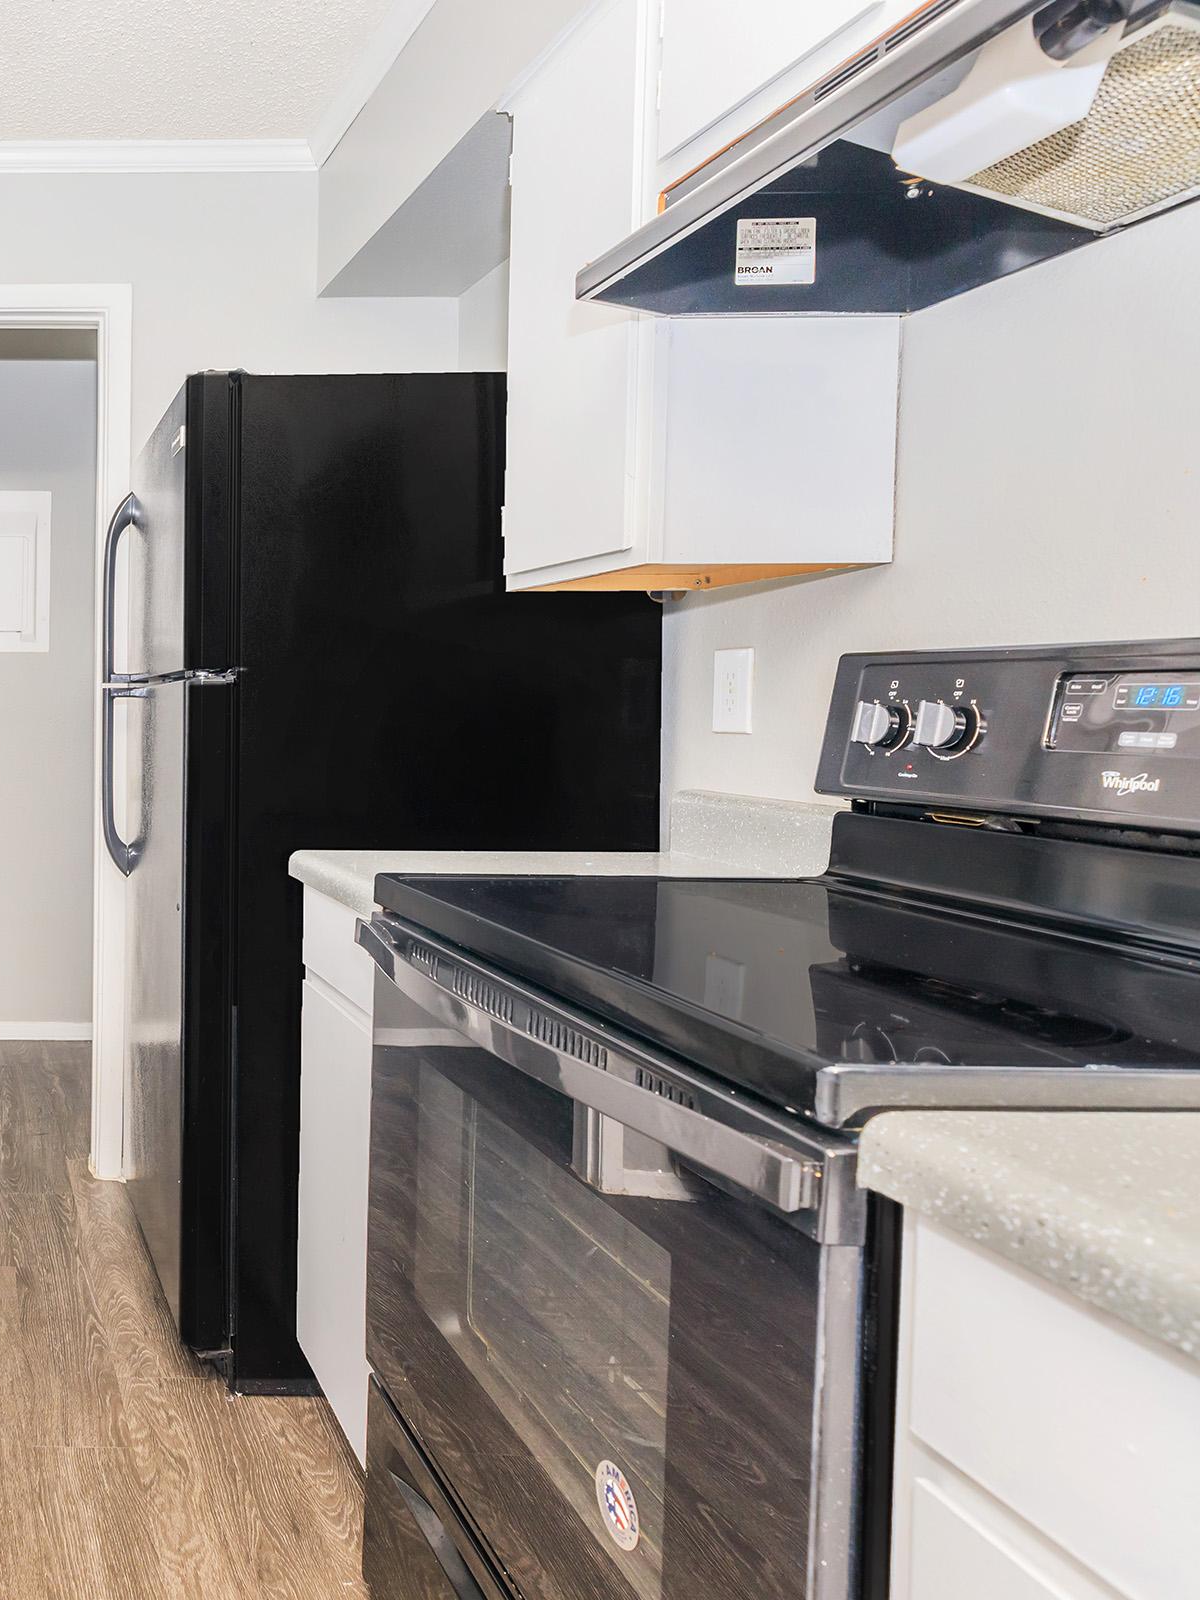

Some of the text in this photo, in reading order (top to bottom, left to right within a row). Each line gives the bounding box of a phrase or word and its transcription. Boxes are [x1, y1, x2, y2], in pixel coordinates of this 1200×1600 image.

[737, 266, 773, 274] BROAN
[1135, 687, 1182, 705] 12:16
[1102, 773, 1160, 795] Whirlpool
[606, 1464, 637, 1533] AMERICA
